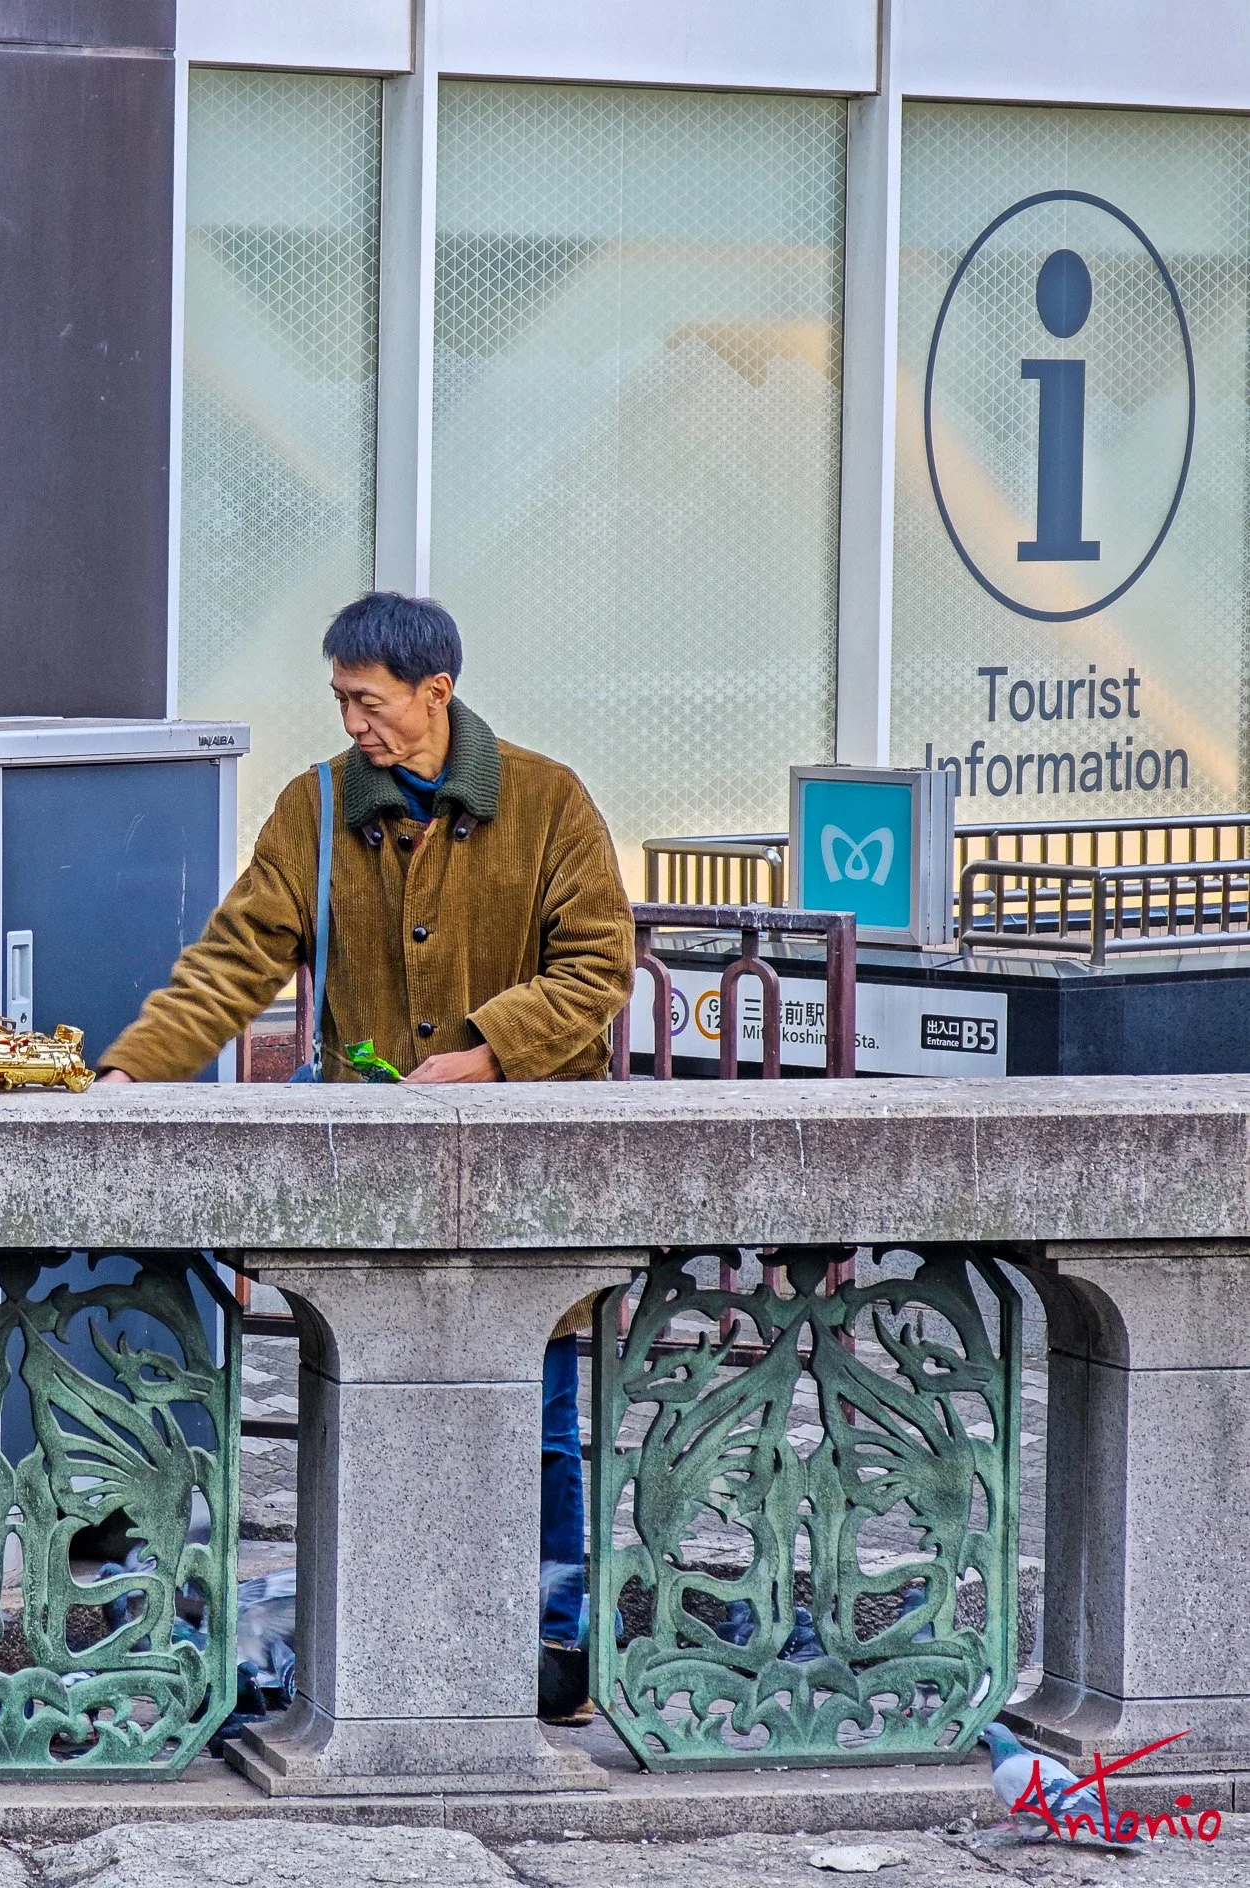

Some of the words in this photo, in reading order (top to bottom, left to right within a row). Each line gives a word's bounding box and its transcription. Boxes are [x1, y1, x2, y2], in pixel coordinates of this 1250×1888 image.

[978, 664, 1141, 722] Tourist
[926, 736, 1189, 797] Information
[709, 999, 719, 1012] G
[743, 999, 825, 1027] 三前駅
[927, 1020, 960, 1036] 出入口
[927, 1036, 960, 1047] Entrance
[962, 1020, 995, 1050] B5
